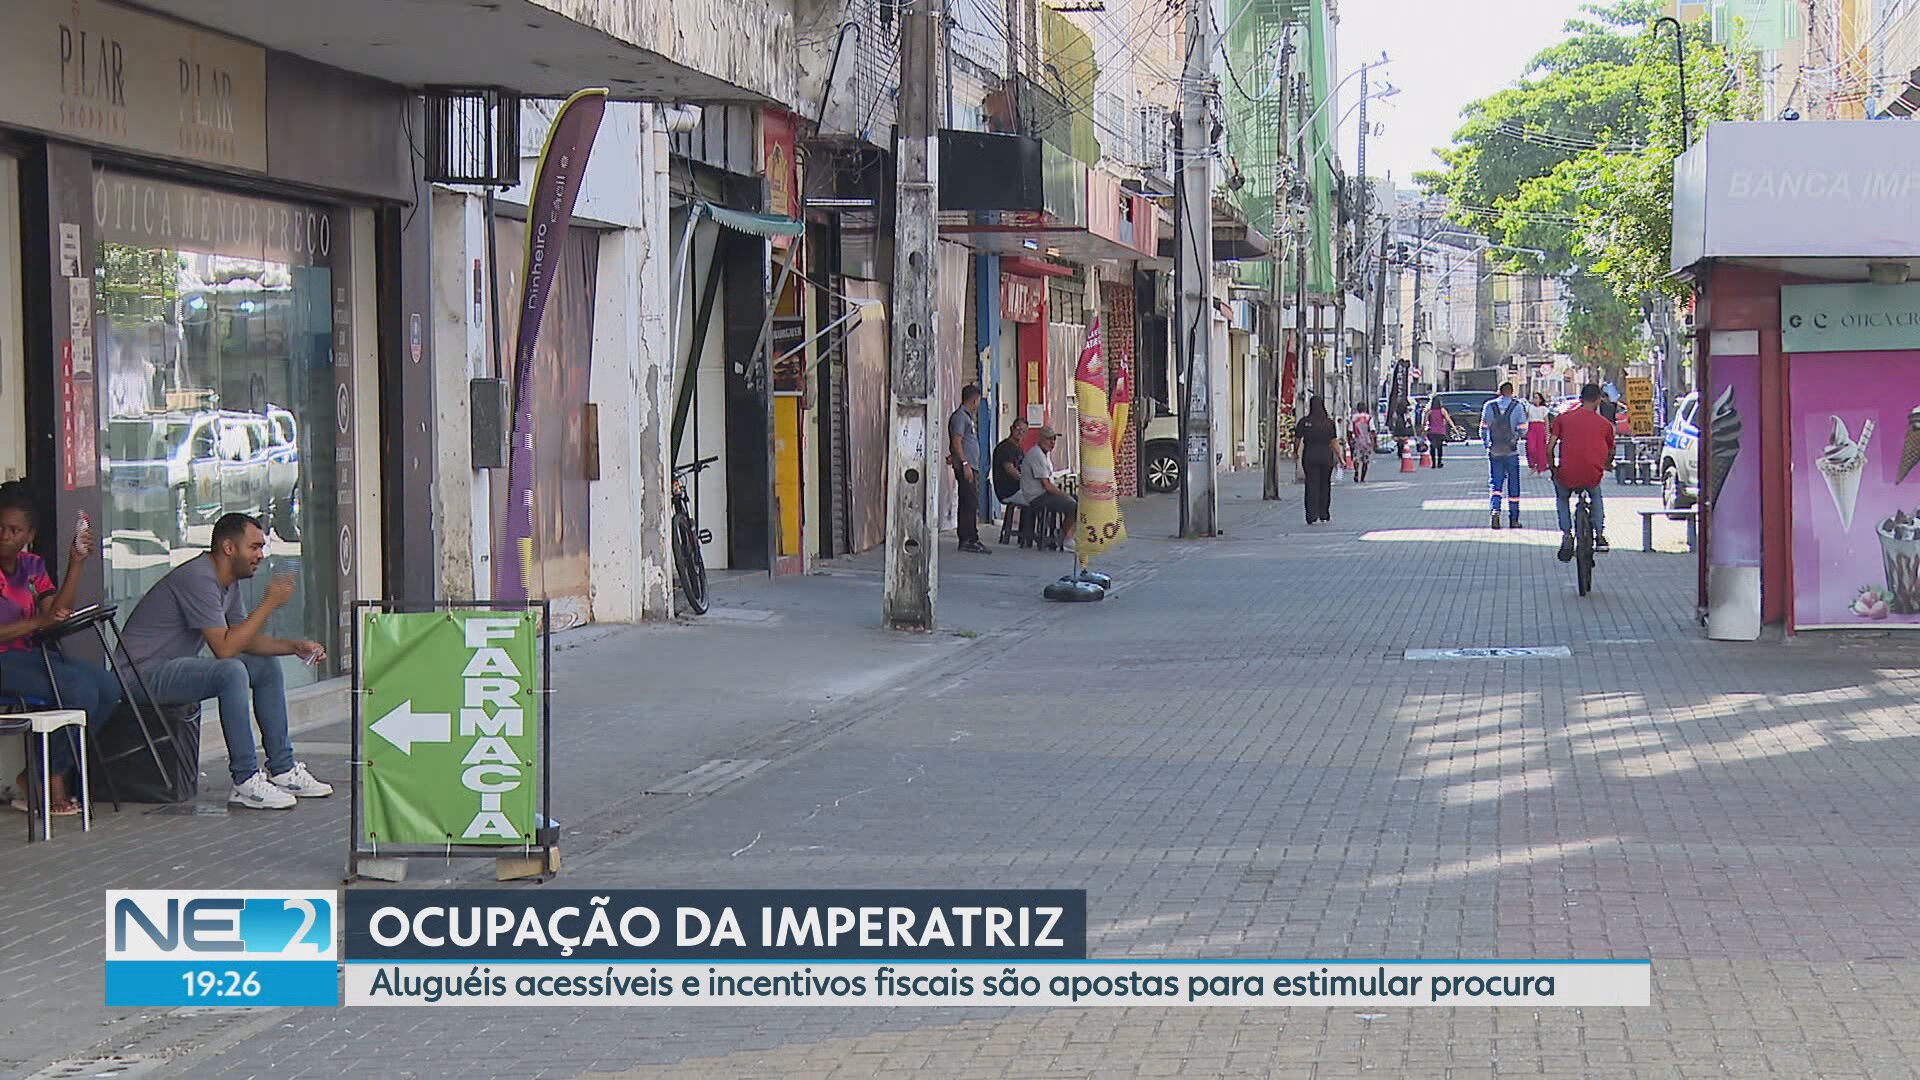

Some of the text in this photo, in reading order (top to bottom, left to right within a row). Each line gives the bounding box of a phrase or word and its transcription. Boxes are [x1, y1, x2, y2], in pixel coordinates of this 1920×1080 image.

[1728, 170, 1850, 199] BANCA
[181, 194, 260, 248] MENOR
[265, 207, 331, 266] PREÇO
[527, 223, 548, 310] Dinheiro
[460, 617, 524, 839] FARMACIA
